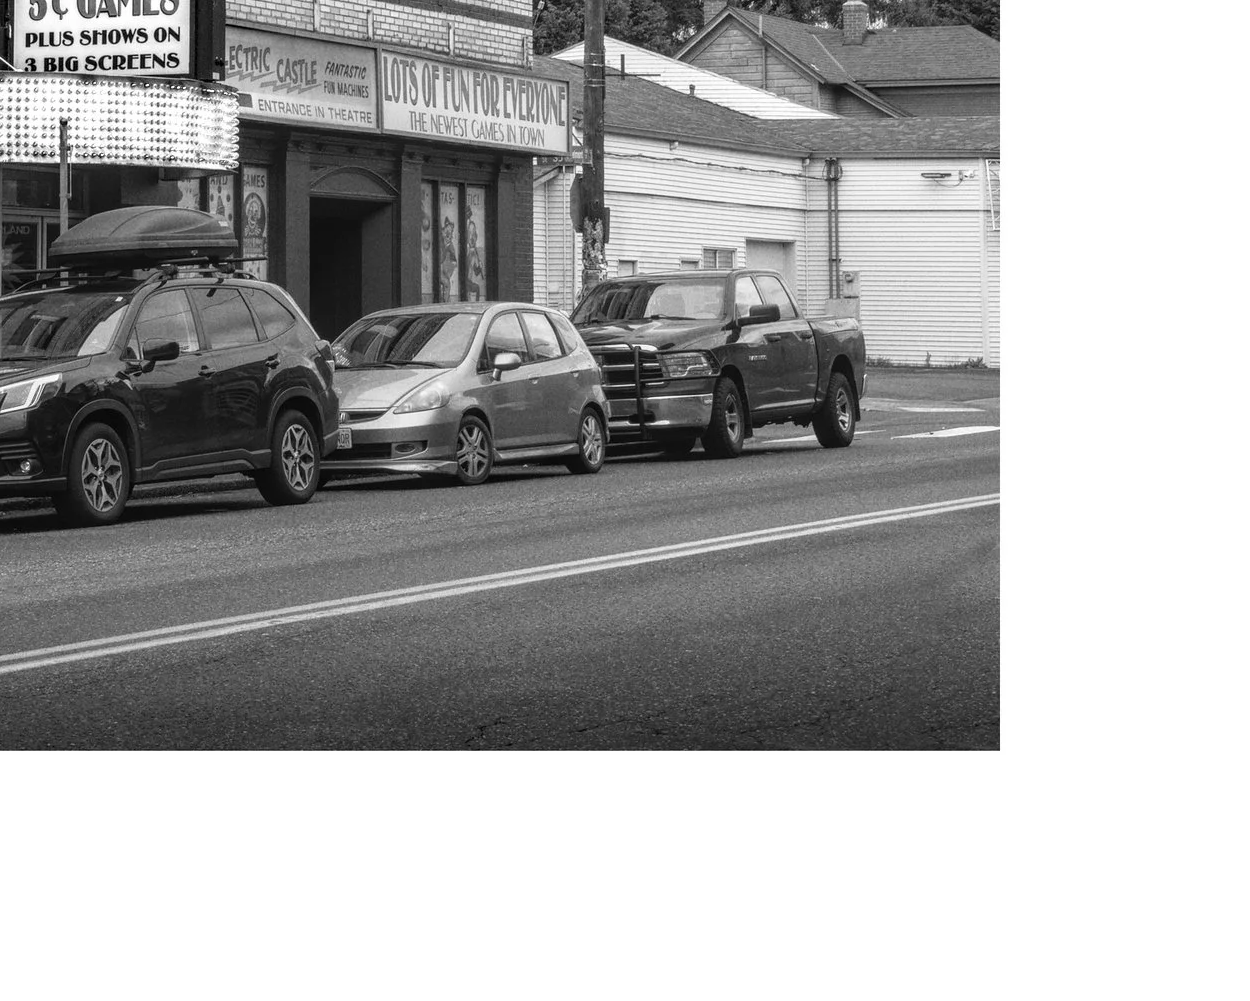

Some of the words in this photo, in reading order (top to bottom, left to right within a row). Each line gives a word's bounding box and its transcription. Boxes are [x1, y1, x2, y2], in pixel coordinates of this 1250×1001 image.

[25, 31, 74, 47] PLUS
[79, 28, 148, 45] SHOWS
[154, 26, 181, 42] ON
[25, 58, 37, 72] 3
[44, 56, 79, 72] BIG
[84, 53, 180, 71] SCREENS
[225, 44, 271, 73] ECTRIC
[276, 58, 318, 85] CASTLE
[324, 61, 367, 79] FANTASTIC
[323, 81, 336, 95] FUN
[337, 82, 370, 99] MACHINES
[383, 56, 419, 106] LOTS
[422, 62, 440, 108] OF
[443, 67, 470, 114] FUN
[473, 71, 500, 118] FOR
[503, 77, 566, 127] EVERYONE
[258, 99, 312, 117] ENTRANCE
[315, 107, 325, 119] IN
[328, 108, 373, 124] THEATRE
[409, 110, 427, 133] THE
[430, 112, 468, 138] NEWEST
[471, 119, 504, 143] GAMES
[507, 125, 517, 144] IN
[518, 126, 545, 148] TOWN
